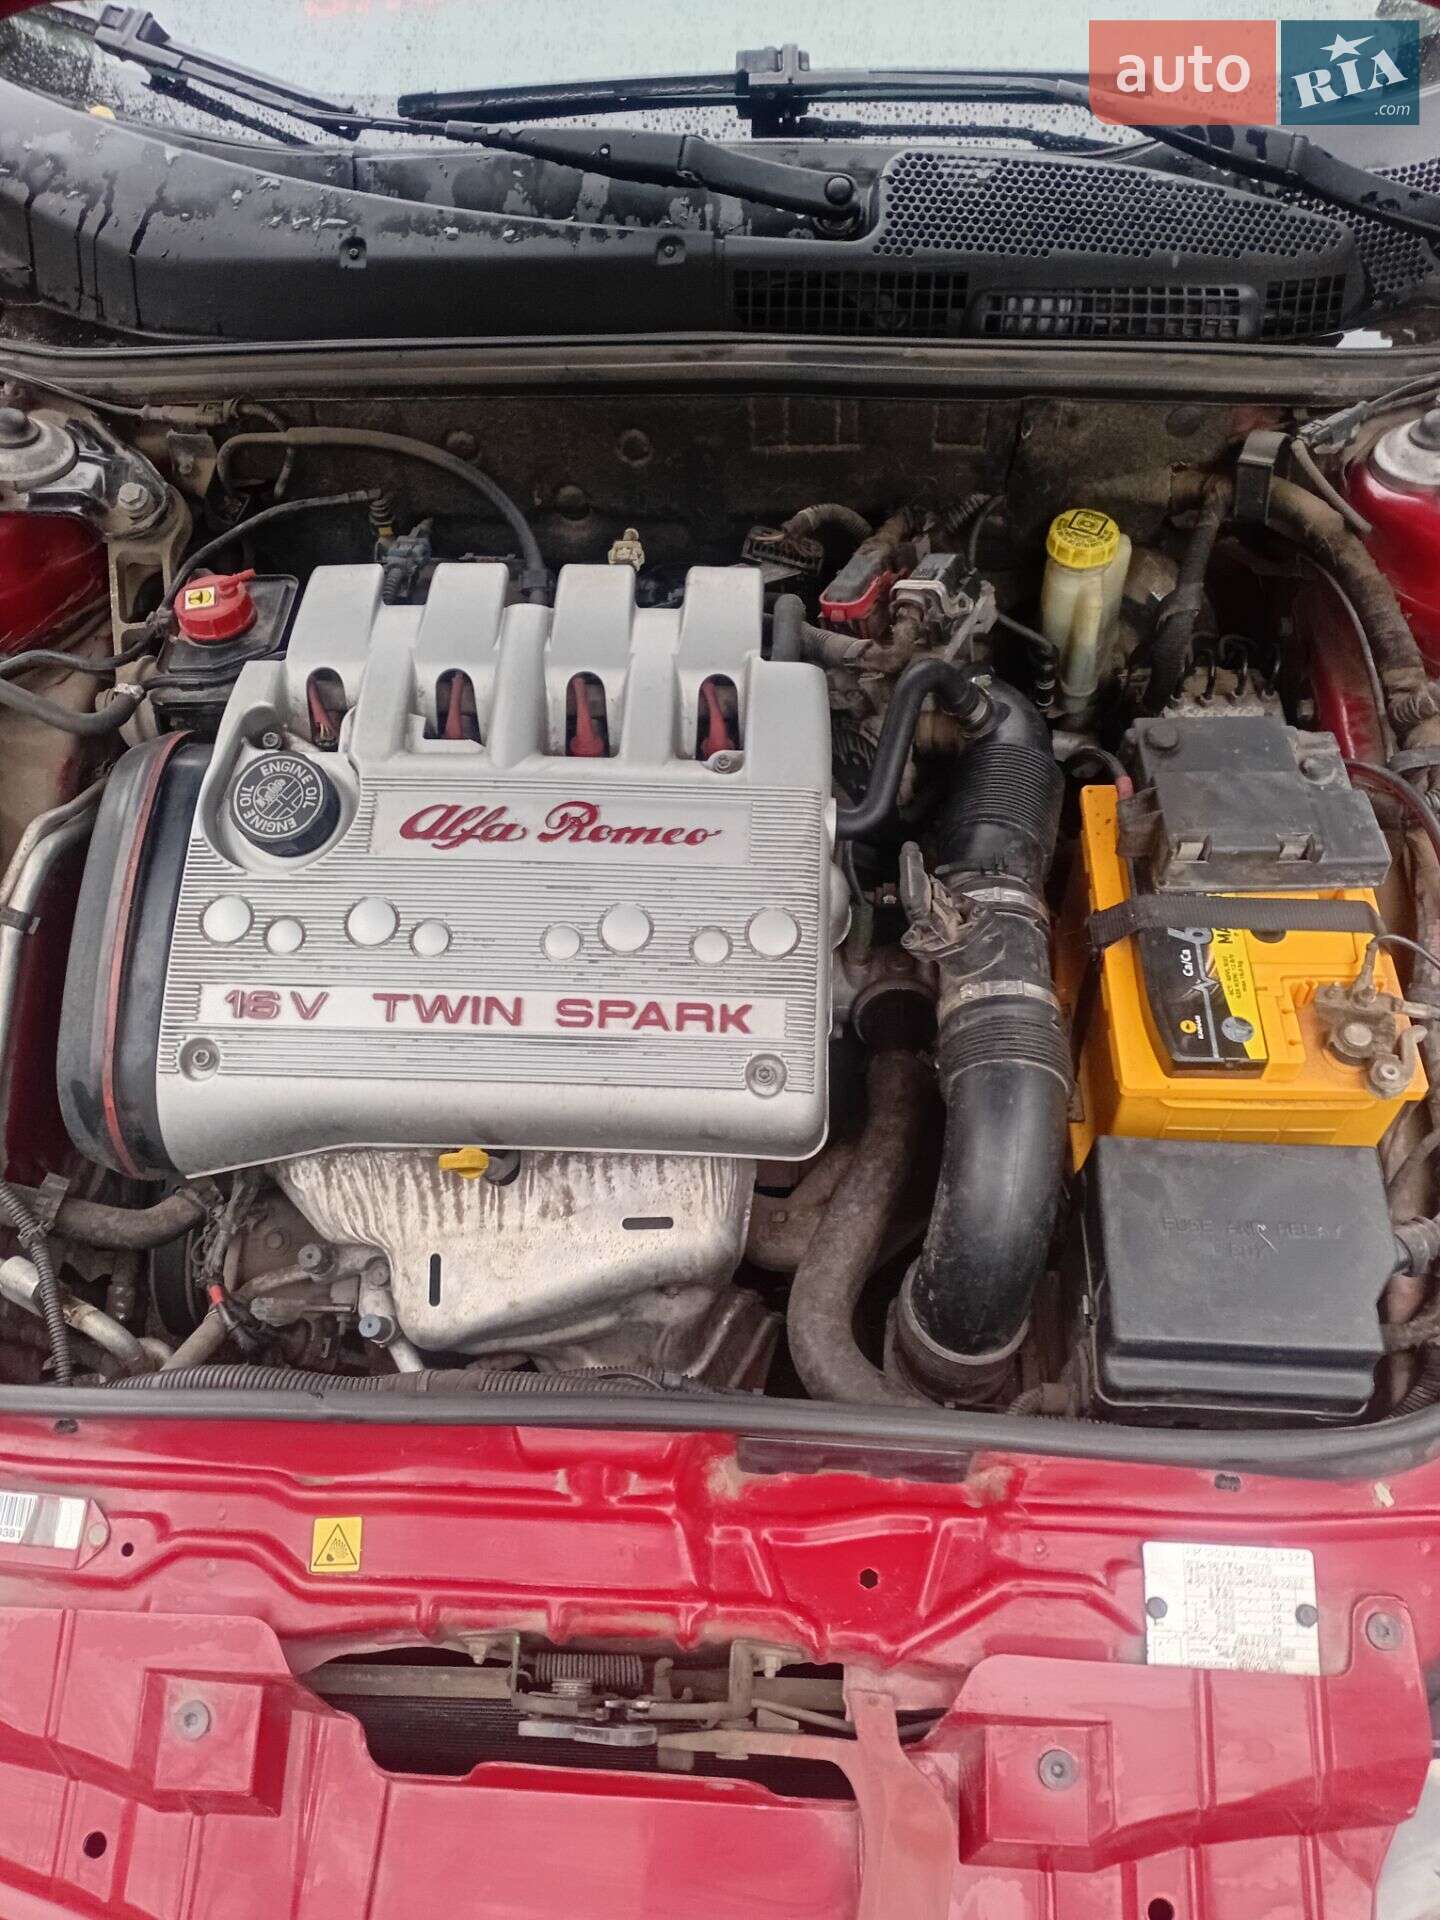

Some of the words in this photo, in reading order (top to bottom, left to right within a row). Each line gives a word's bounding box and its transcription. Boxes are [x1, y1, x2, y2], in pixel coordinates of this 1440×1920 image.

[240, 785, 254, 807] OIL
[260, 761, 313, 784] ENGINE
[303, 786, 317, 808] OIL
[243, 809, 297, 833] ENGINE
[399, 803, 527, 850] Alfa
[537, 800, 722, 846] Romeo
[1180, 949, 1194, 977] Ca/Ca
[373, 993, 522, 1026] TWIN
[556, 998, 752, 1034] SPARK
